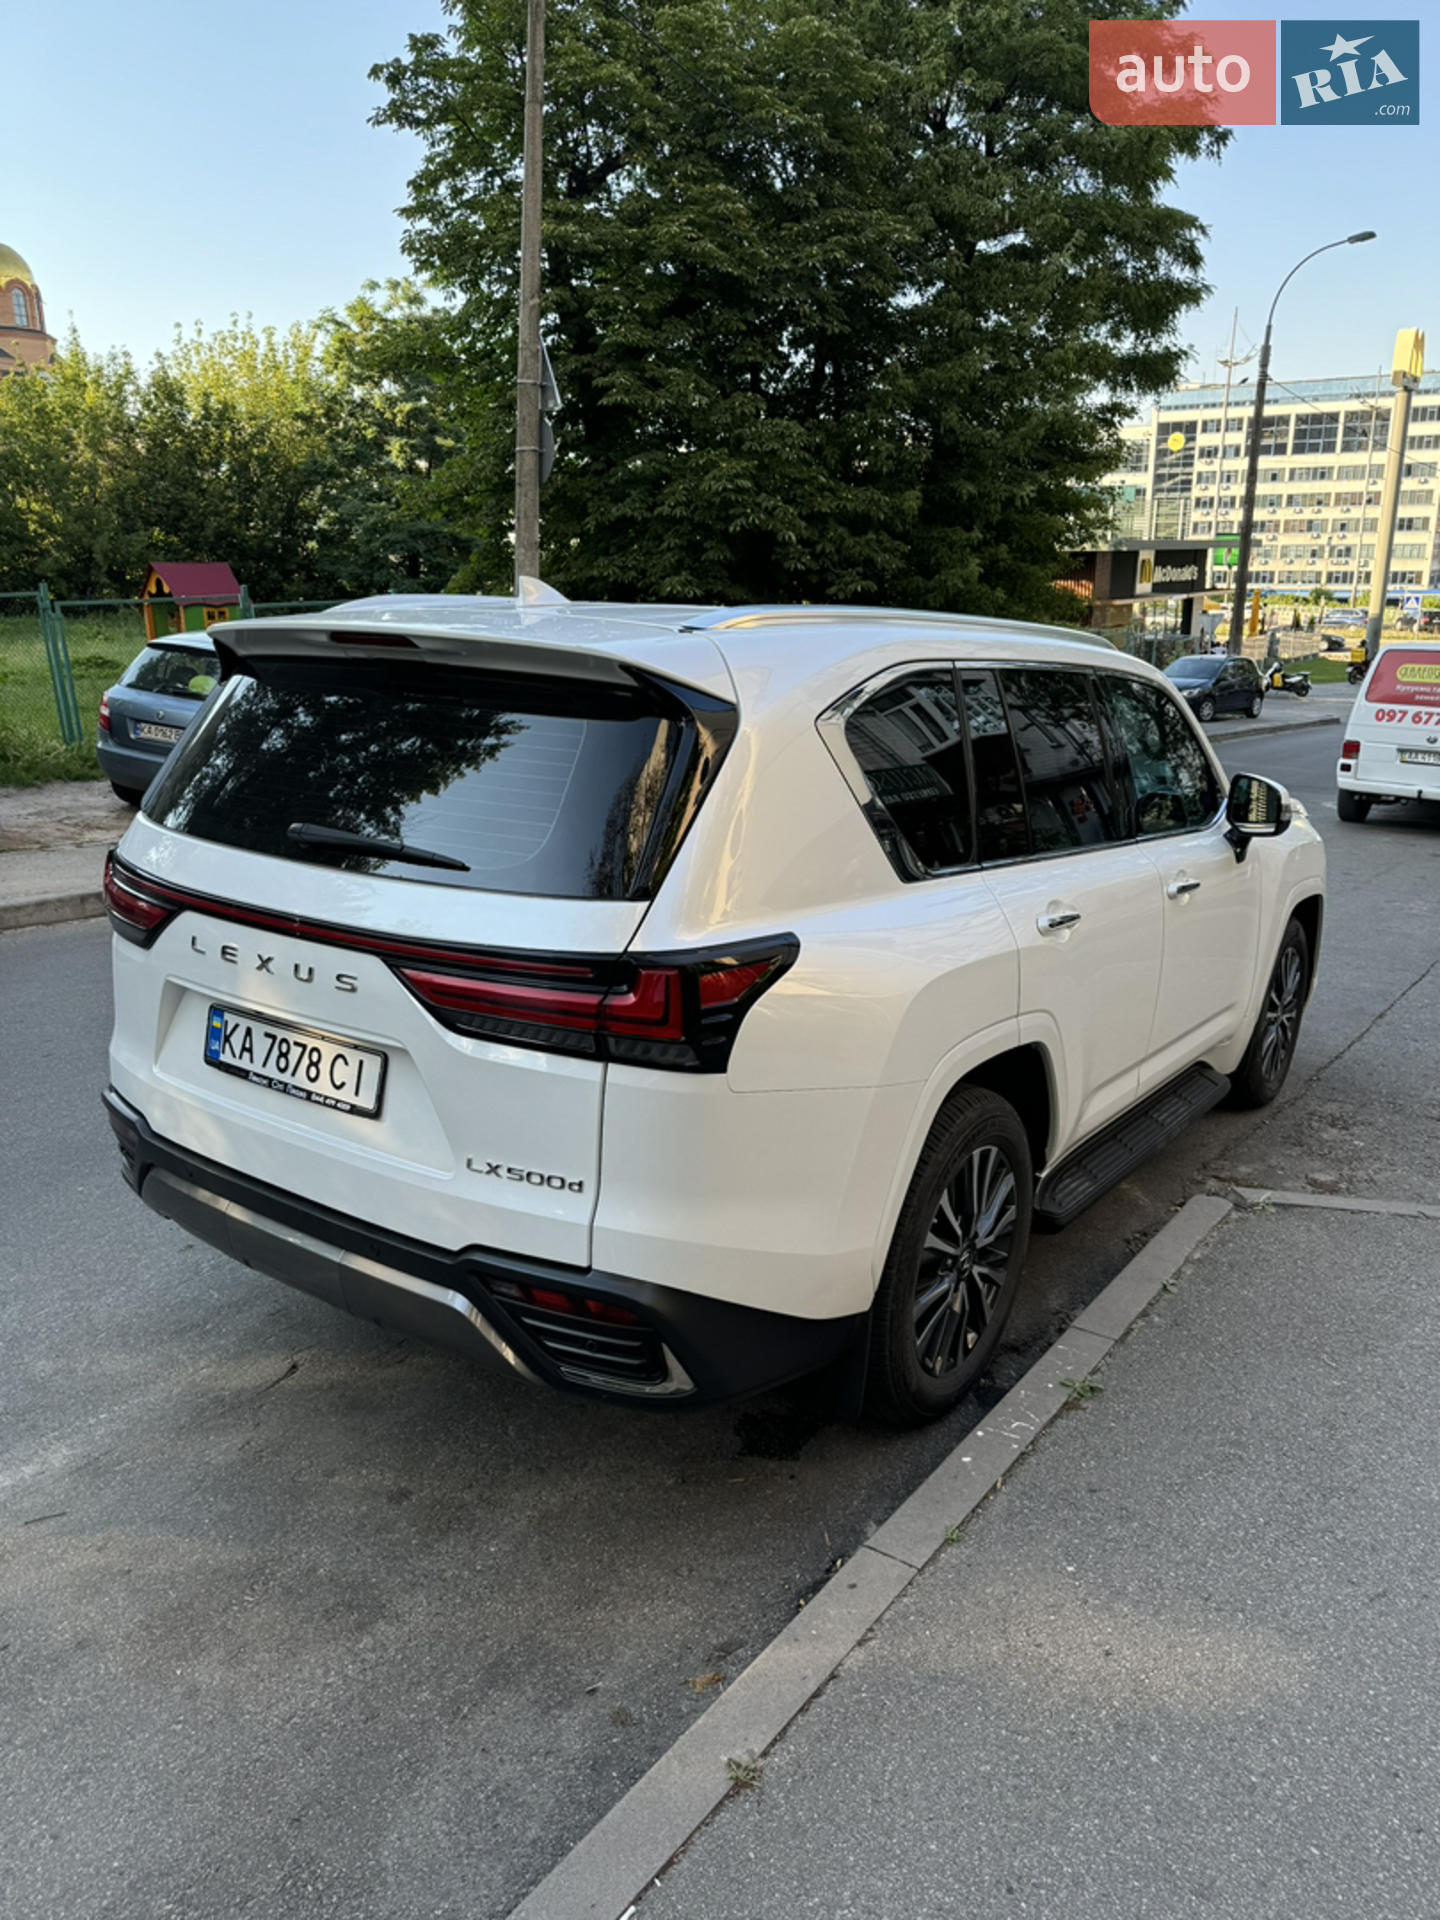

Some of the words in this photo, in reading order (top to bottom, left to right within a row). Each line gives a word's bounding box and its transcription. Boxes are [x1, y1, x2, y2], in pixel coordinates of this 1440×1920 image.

[1153, 565, 1199, 583] McDonald's
[1375, 708, 1408, 723] 097
[191, 935, 358, 993] LEXUS
[222, 1019, 254, 1064] KA
[262, 1031, 322, 1083] 7878
[329, 1053, 364, 1097] CI
